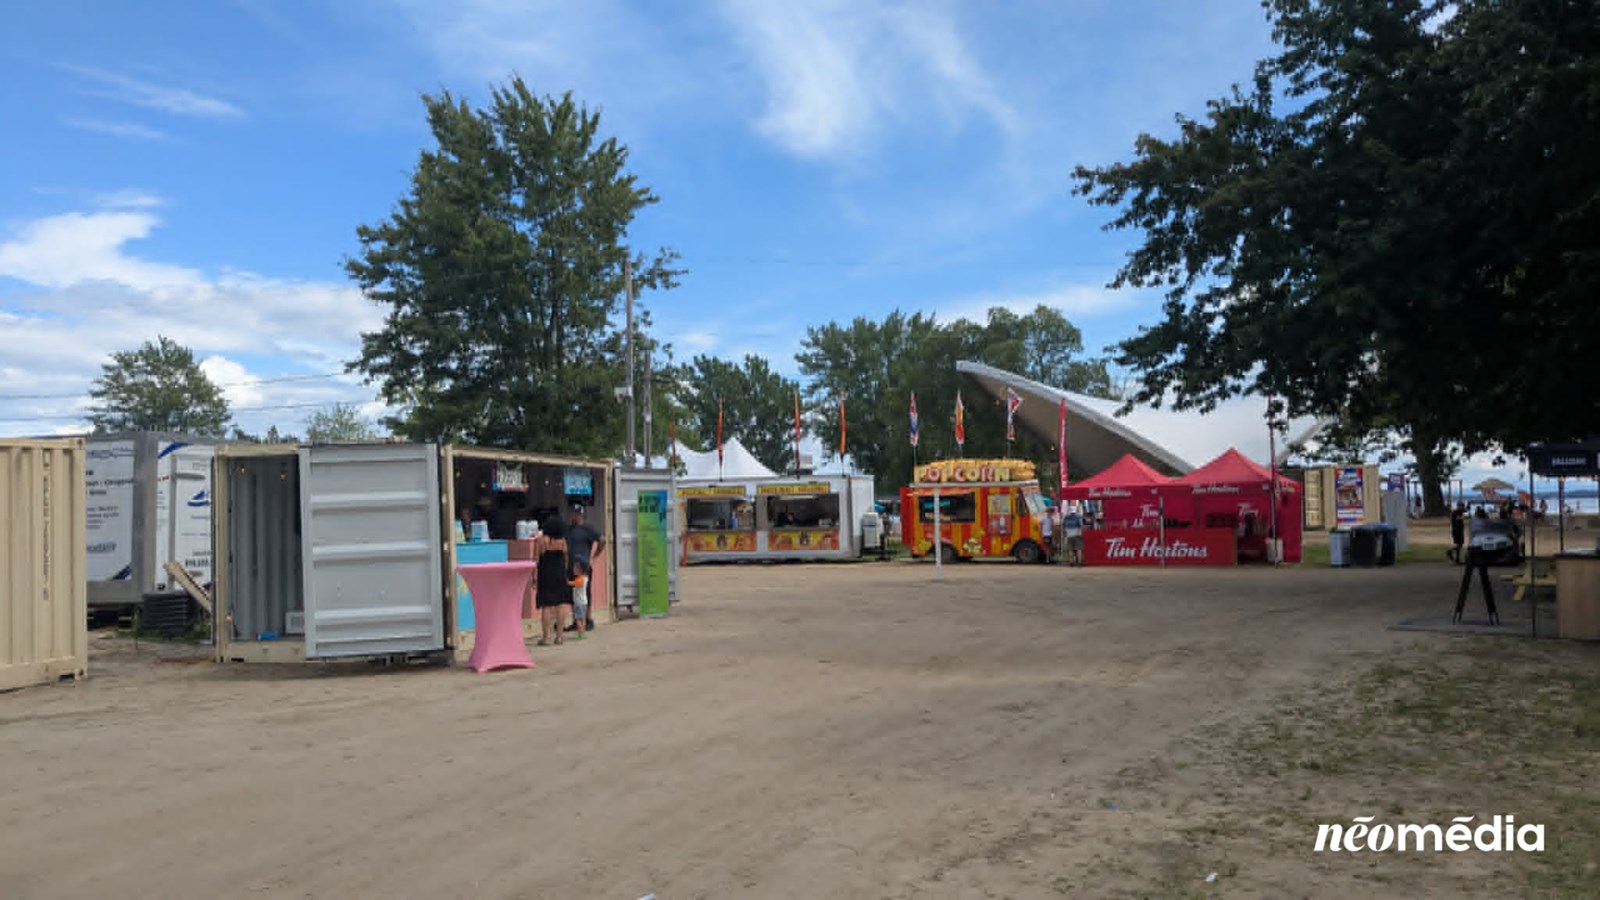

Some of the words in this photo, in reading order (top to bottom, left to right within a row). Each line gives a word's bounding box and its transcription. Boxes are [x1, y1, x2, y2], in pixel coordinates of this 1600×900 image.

[913, 464, 1010, 483] POPCORN
[1105, 537, 1135, 558] Tim
[1139, 536, 1208, 559] Hortons
